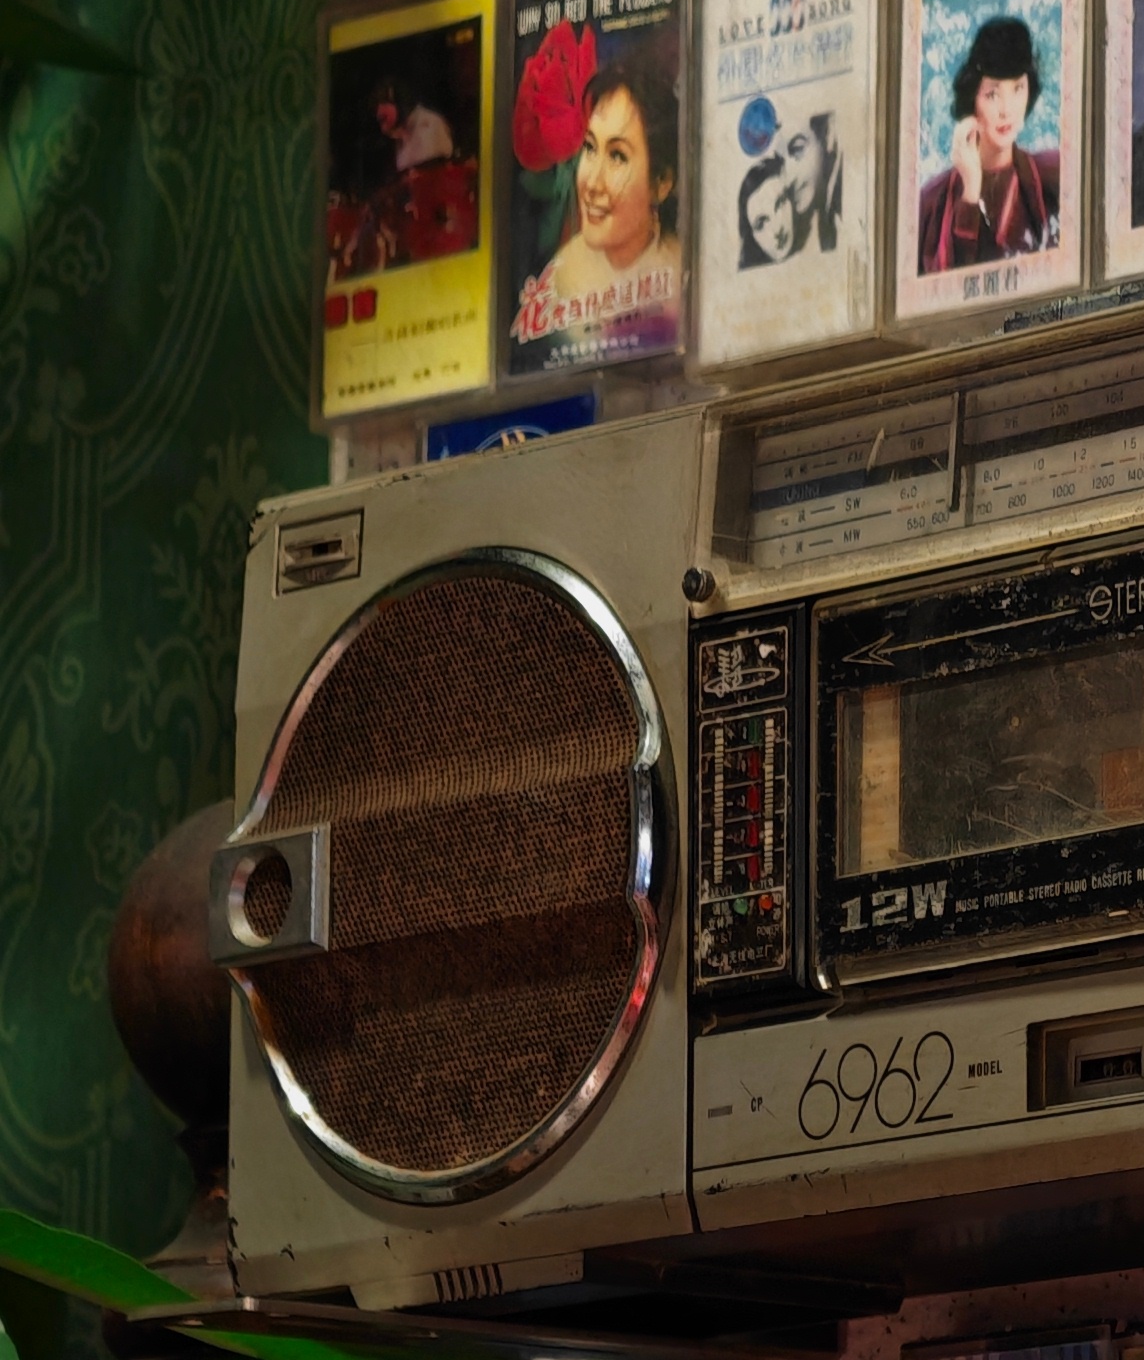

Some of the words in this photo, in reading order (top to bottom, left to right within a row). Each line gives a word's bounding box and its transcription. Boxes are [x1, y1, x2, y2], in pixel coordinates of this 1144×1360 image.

[844, 497, 861, 512] SW
[1073, 448, 1087, 462] 12
[1052, 482, 1076, 498] 1000
[1092, 473, 1115, 490] 1200
[839, 879, 948, 934] 12W
[983, 888, 1025, 910] PORTABLE
[1028, 882, 1061, 902] STEREO
[1064, 877, 1088, 894] RADIO
[1090, 869, 1133, 890] CASSETTE
[798, 1030, 955, 1141] 6962
[967, 1058, 1004, 1080] MODEL
